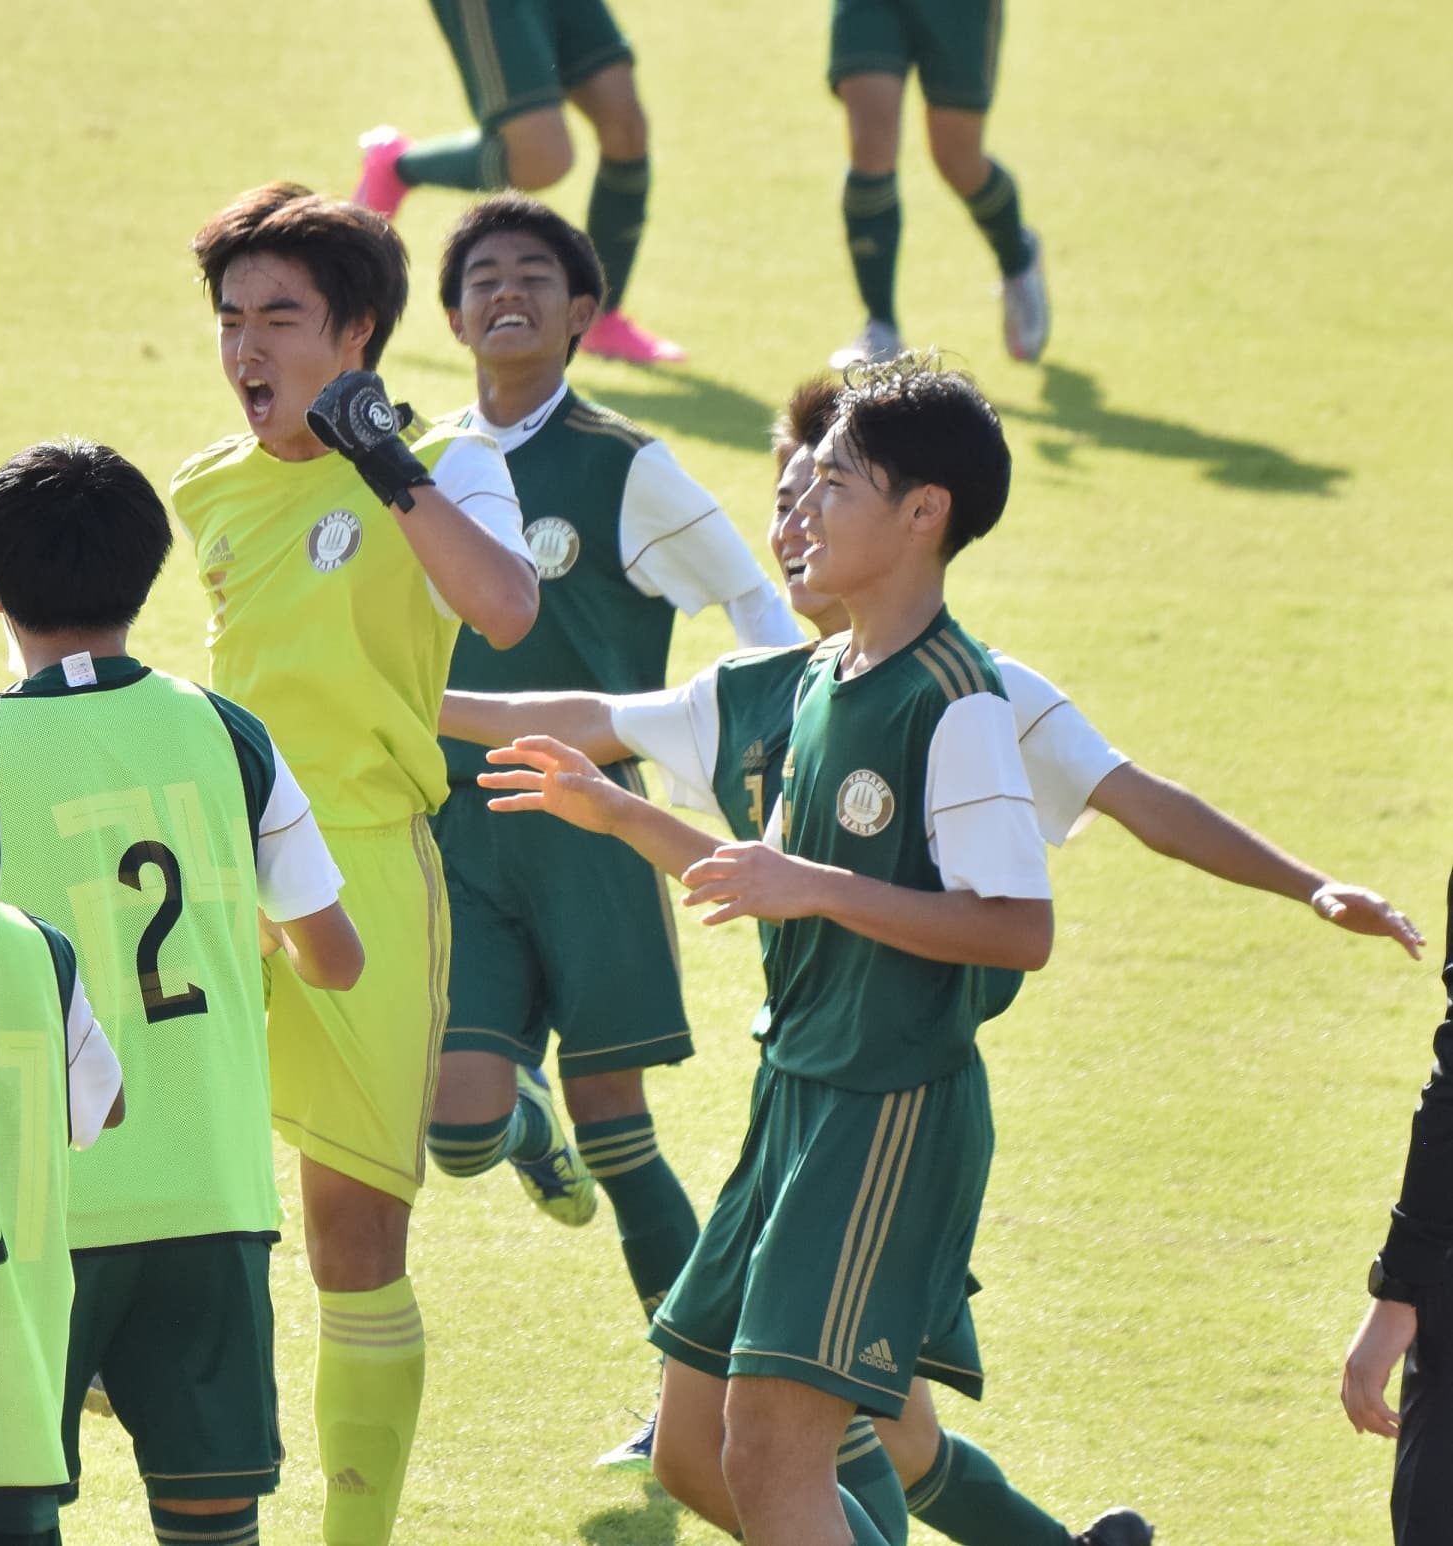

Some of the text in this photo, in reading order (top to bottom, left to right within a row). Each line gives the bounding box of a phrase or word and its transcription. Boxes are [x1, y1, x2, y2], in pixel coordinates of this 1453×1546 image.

[318, 511, 358, 532] YAMABE
[314, 558, 343, 572] NARA
[848, 771, 891, 800] YAMABE
[840, 814, 878, 835] NARA
[118, 840, 209, 1025] 2
[858, 1352, 899, 1374] adidas
